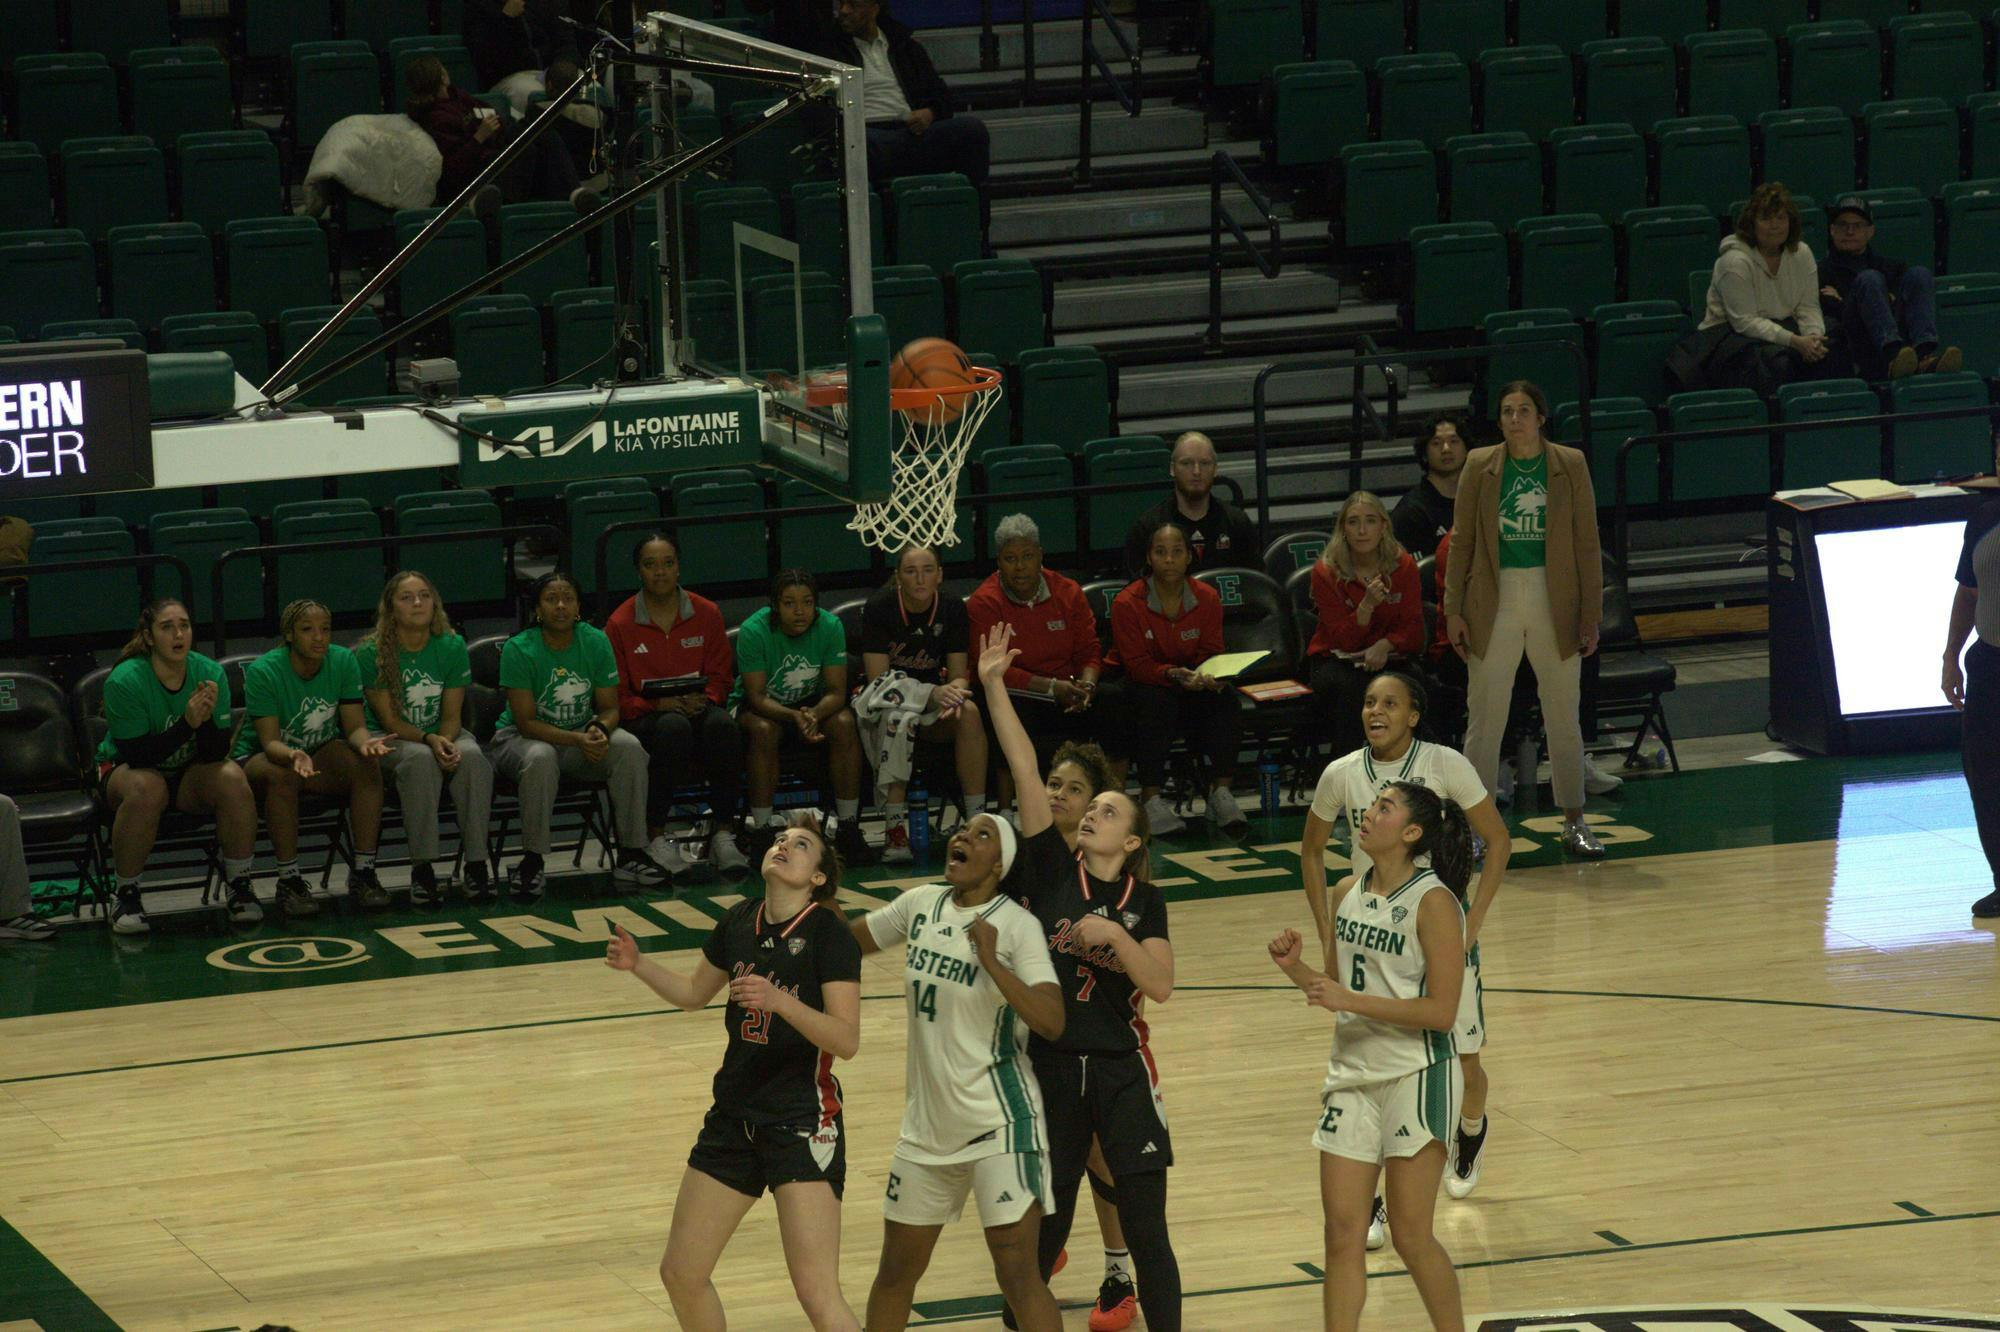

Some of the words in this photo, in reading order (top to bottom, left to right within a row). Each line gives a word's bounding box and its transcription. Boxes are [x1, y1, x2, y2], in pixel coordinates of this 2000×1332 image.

[0, 380, 84, 431] ERN
[615, 437, 644, 453] KIA
[649, 430, 740, 450] YPSILANTI
[1216, 575, 1243, 606] E
[910, 913, 927, 940] C
[1076, 964, 1097, 1002] 7
[1350, 953, 1366, 992] 6
[912, 979, 938, 1022] 14
[741, 1007, 773, 1046] 21
[1320, 1106, 1343, 1134] E
[886, 1172, 901, 1202] E
